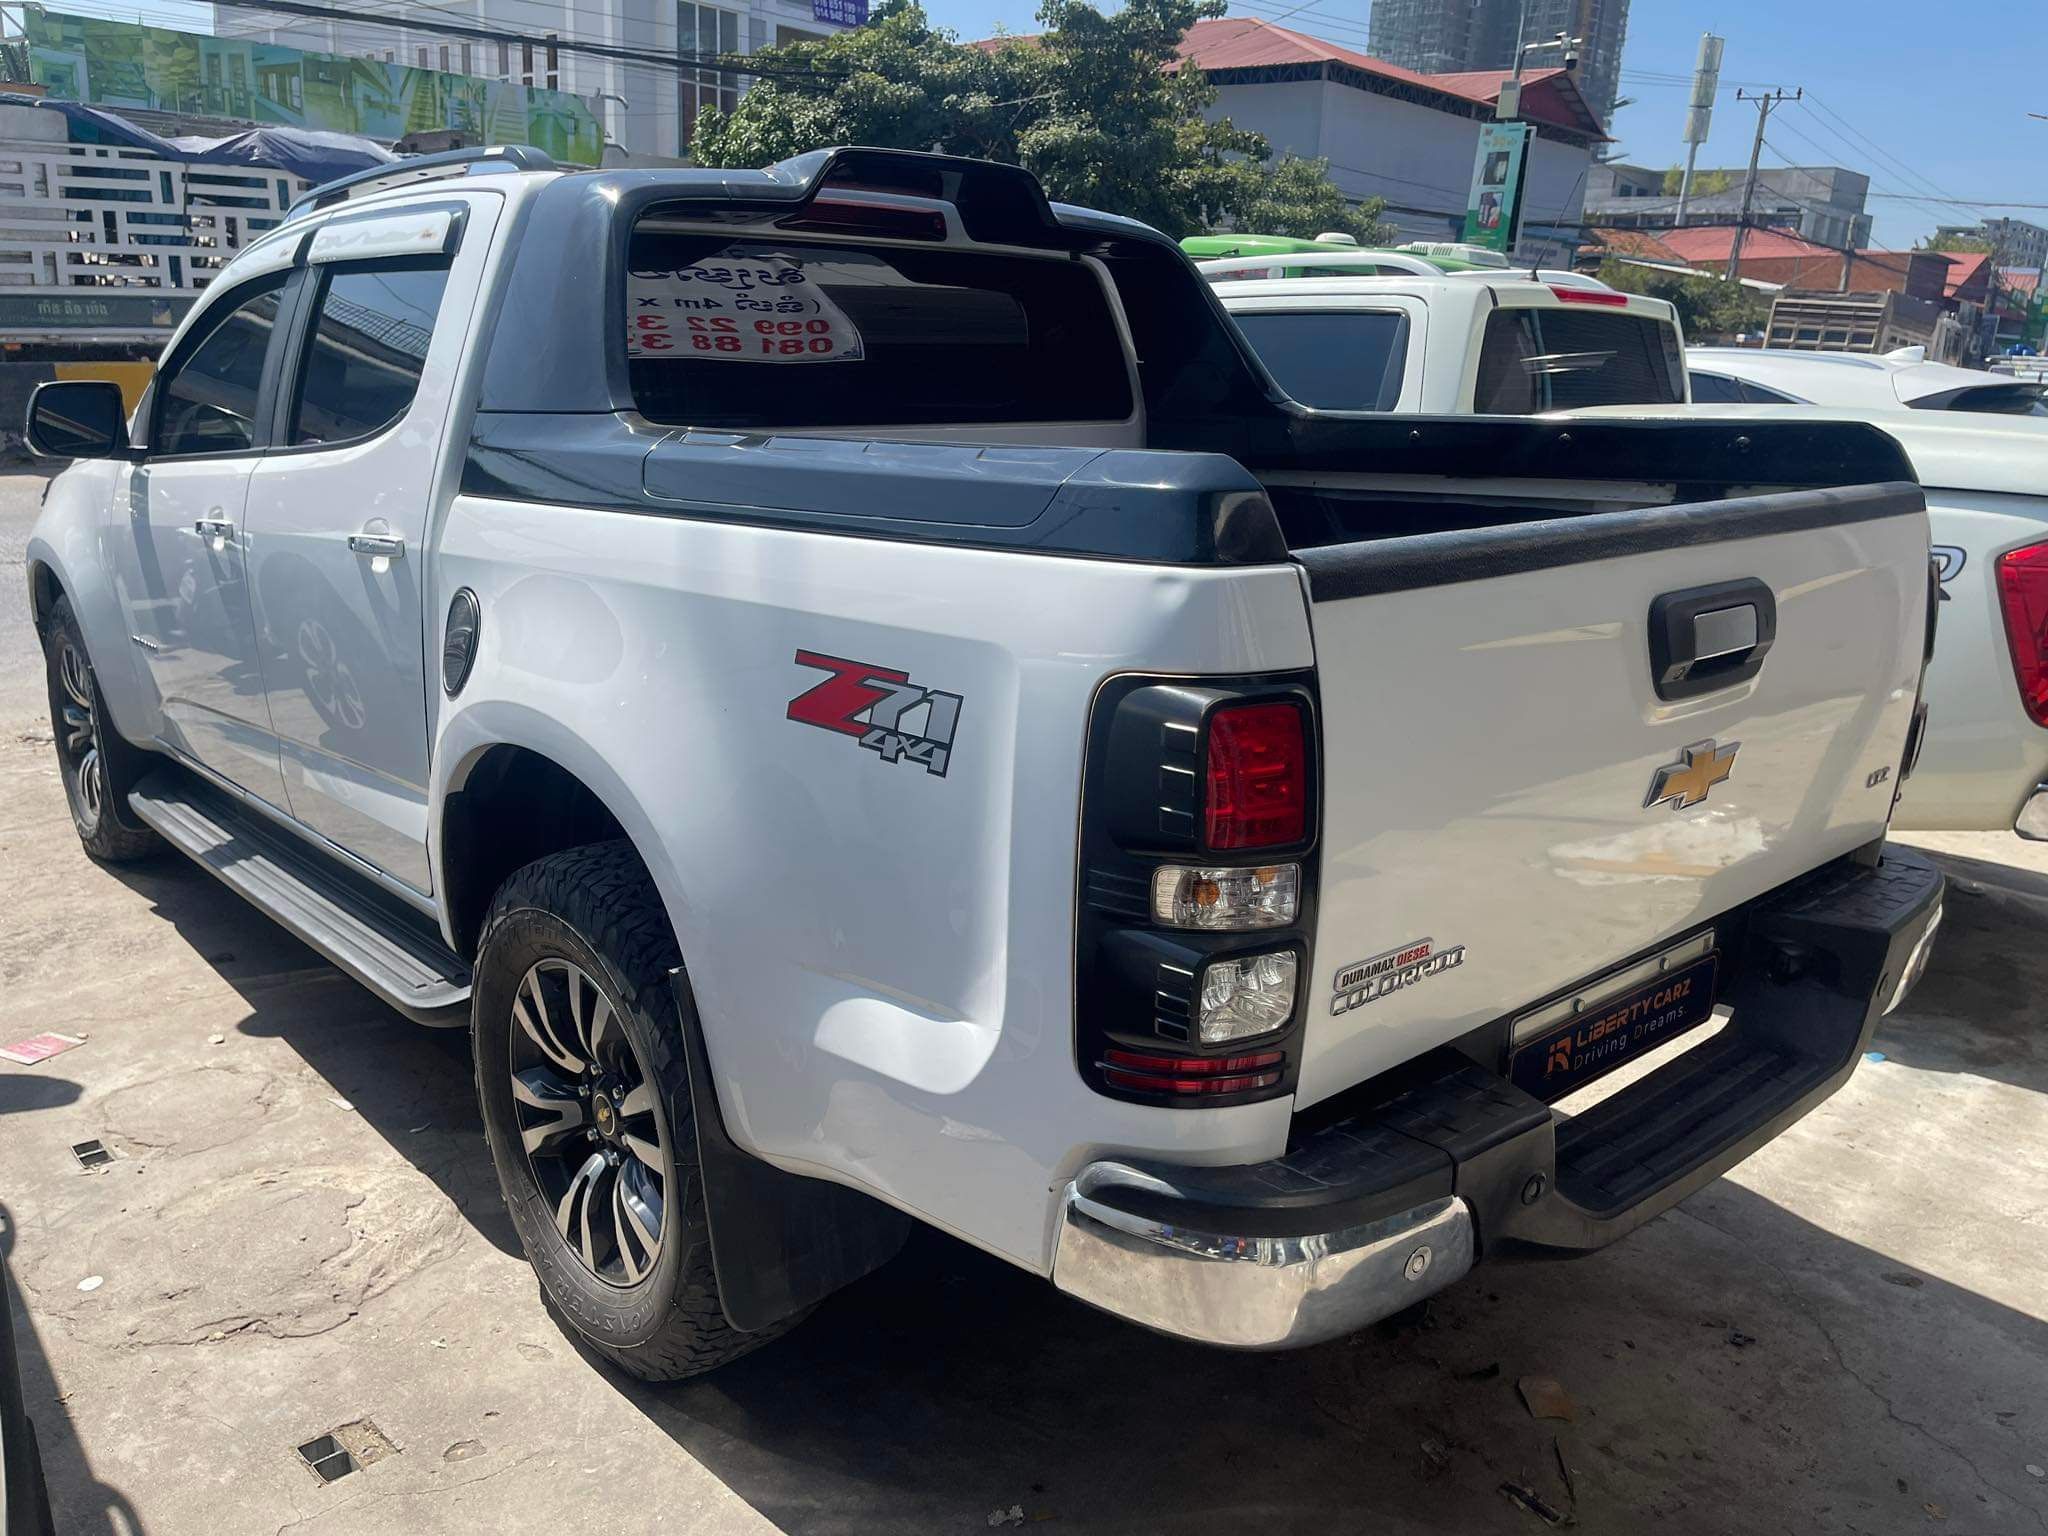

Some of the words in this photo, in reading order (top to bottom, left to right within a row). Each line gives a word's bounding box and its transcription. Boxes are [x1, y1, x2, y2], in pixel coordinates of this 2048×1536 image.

[786, 648, 965, 746] Z71
[1329, 944, 1467, 1017] COLORADO
[1341, 955, 1396, 988] DURAMAX
[1396, 943, 1431, 967] DIESEL
[1652, 977, 1692, 1009] CARZ
[1573, 1032, 1627, 1071] Driving
